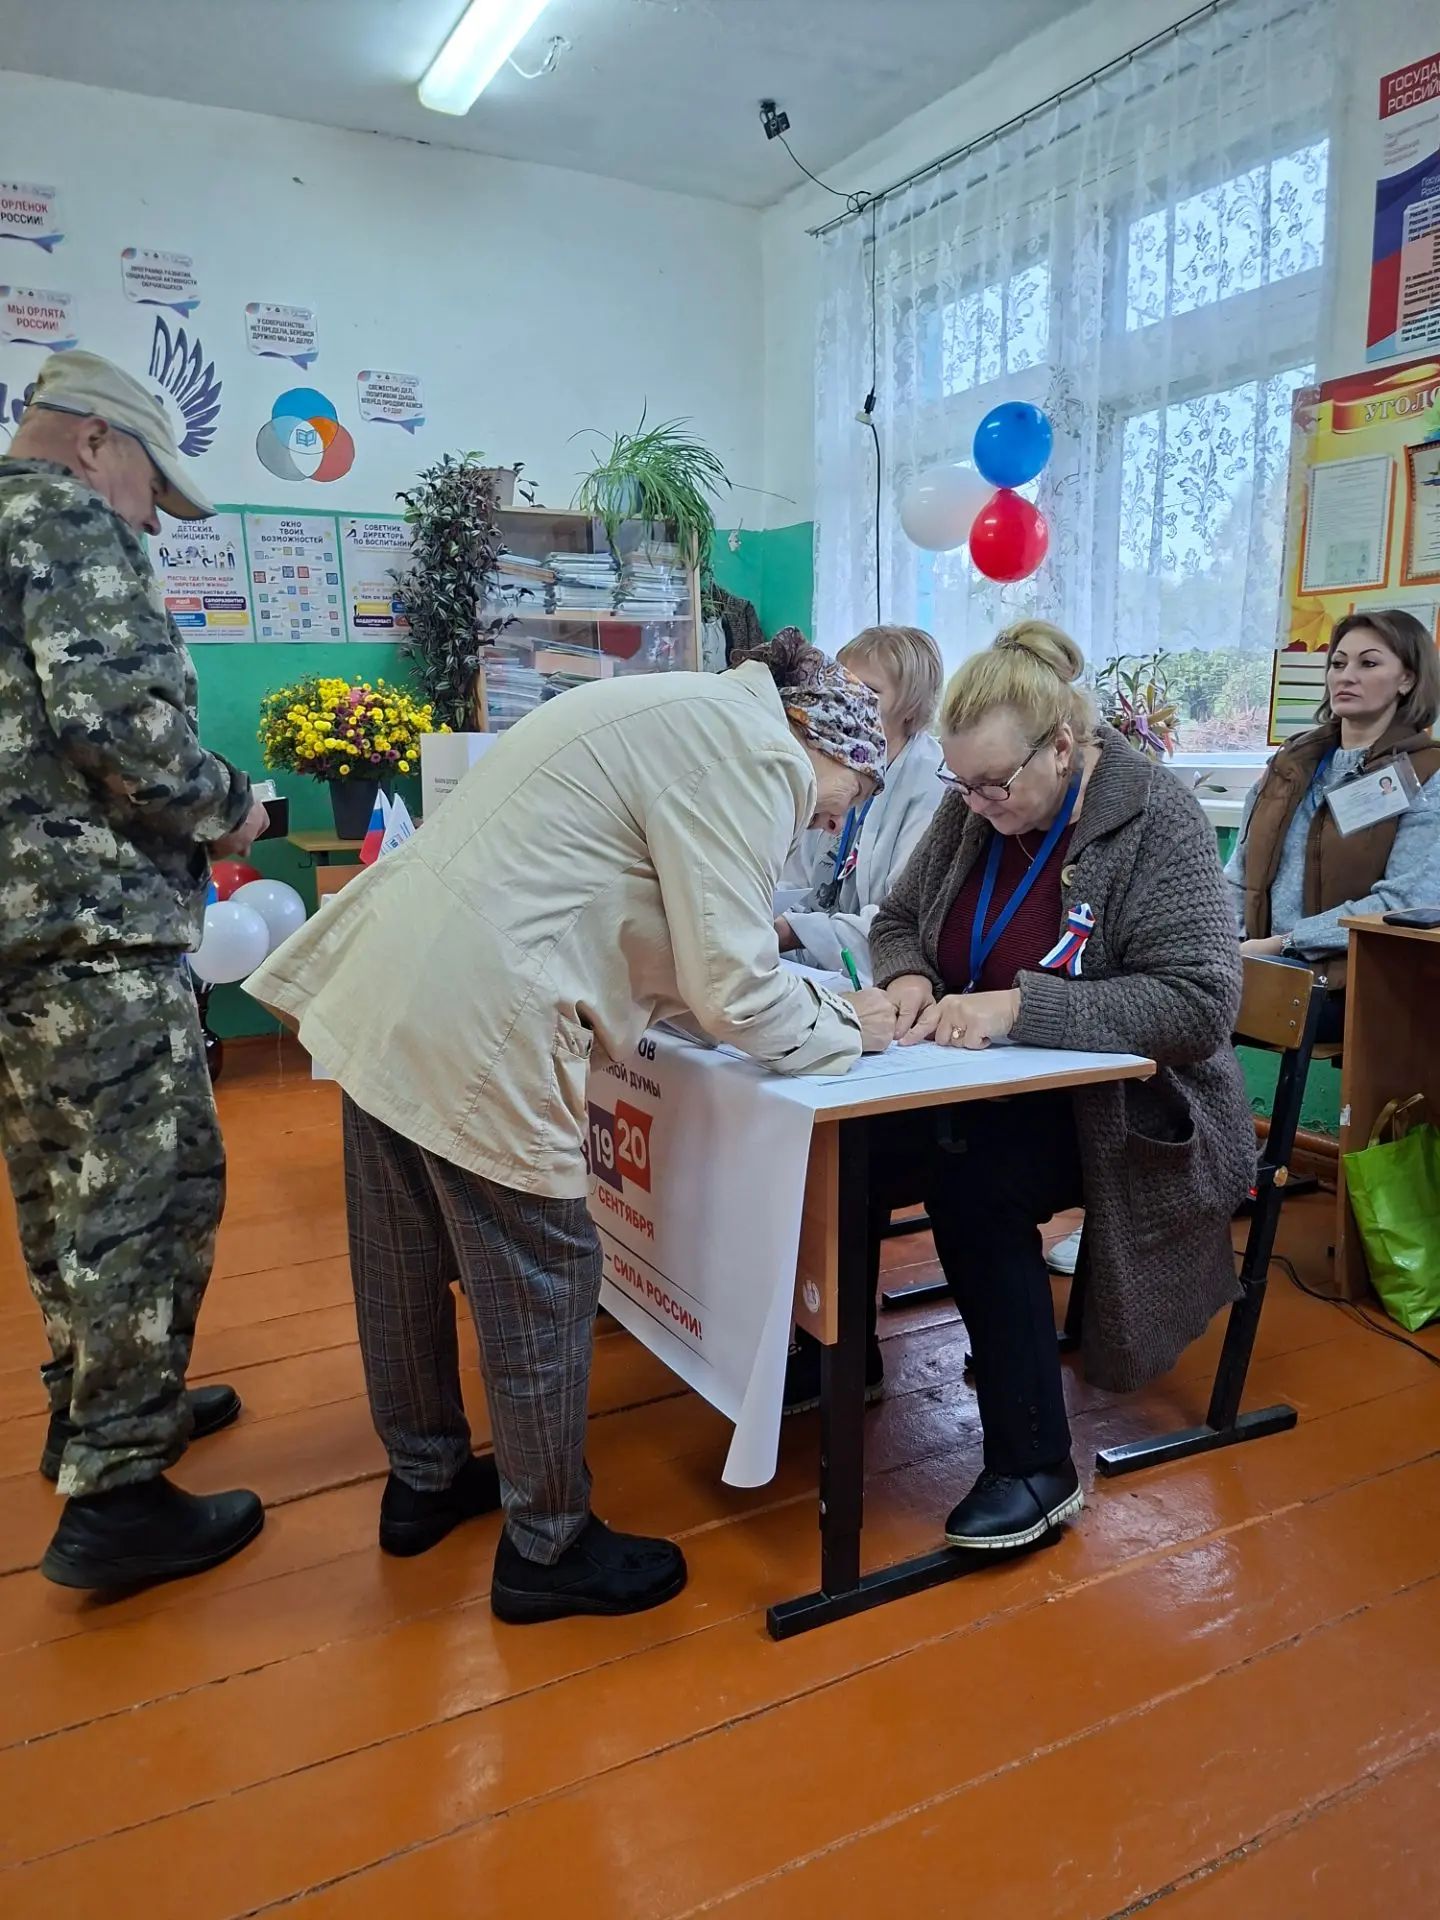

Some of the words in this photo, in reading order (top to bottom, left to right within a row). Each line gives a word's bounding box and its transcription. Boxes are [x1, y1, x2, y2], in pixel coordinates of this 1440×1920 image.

[0, 212, 44, 226] РОССИИ!
[7, 304, 25, 315] МЫ
[27, 306, 66, 319] ОРЛЯТА
[176, 525, 214, 533] ДЕТСКИХ
[280, 520, 302, 528] ОКНО
[364, 523, 402, 532] СОВЕТНИК
[279, 527, 304, 536] ТВОИХ
[362, 531, 405, 540] ДИРЕКТОРА
[171, 532, 221, 542] ИНИЦИАТИВ
[261, 535, 324, 544] ВОЗМОЖНОСТЕЙ
[353, 538, 364, 546] ПО
[629, 1070, 662, 1100] ДУМЫ
[592, 1123, 615, 1170] 19
[617, 1117, 647, 1171] 20
[598, 1185, 655, 1242] СЕНТЯБРЯ
[613, 1254, 645, 1293] СИЛА
[646, 1279, 703, 1341] РОССИИ!
